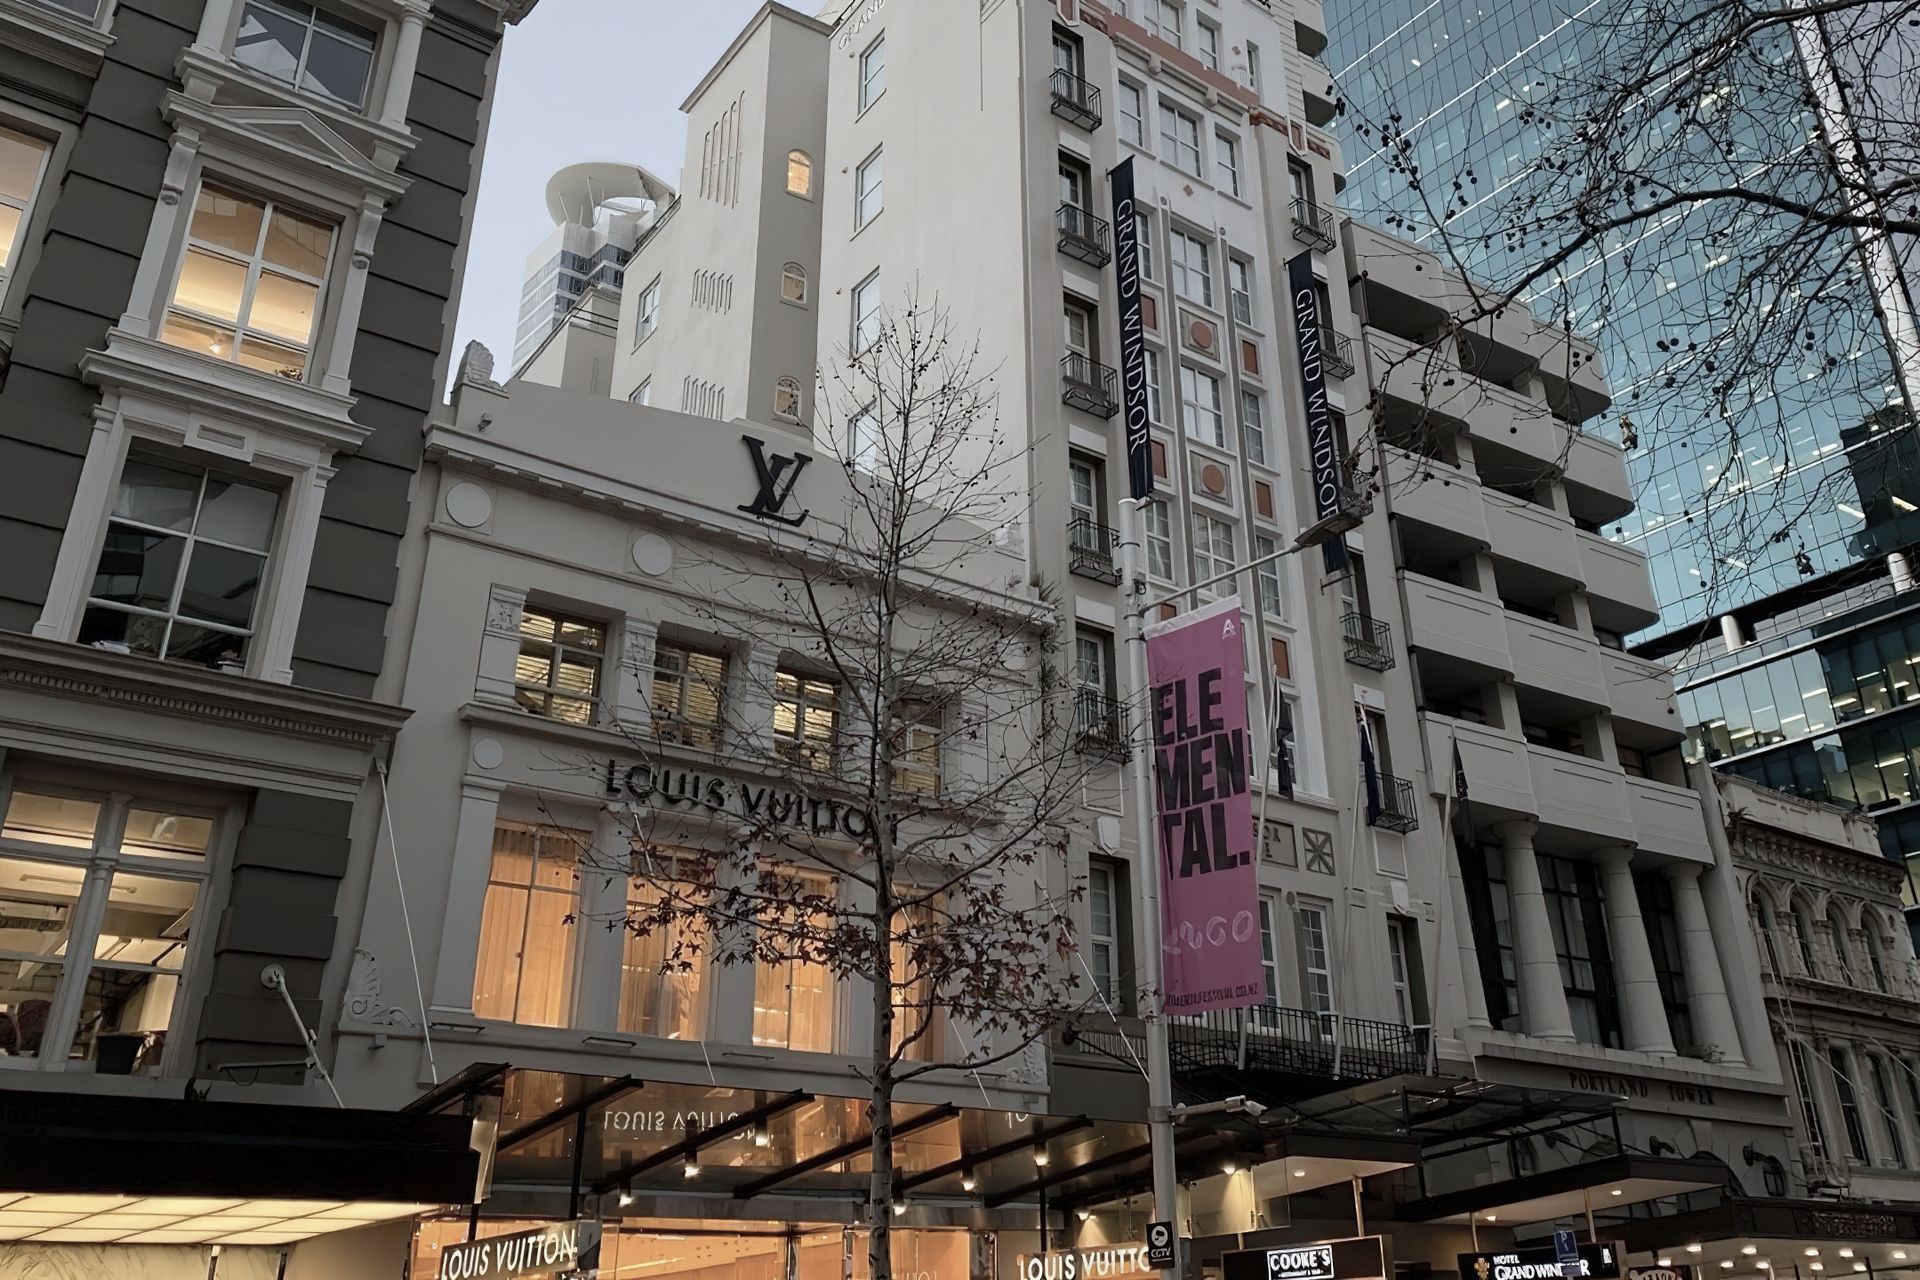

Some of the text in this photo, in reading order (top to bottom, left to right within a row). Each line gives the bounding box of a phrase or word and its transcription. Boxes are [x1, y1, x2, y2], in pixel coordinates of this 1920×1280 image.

[1116, 199, 1147, 455] GRAND WINDSOR
[1296, 289, 1322, 382] GRAND
[1150, 667, 1224, 746] ELE
[1154, 727, 1246, 811] MEN
[606, 758, 898, 846] LOUIS VUITTO
[1163, 802, 1250, 881] TAL.
[1568, 1071, 1716, 1105] PORTLAND TOWER
[441, 1229, 577, 1280] LOUIS VUITTON
[1017, 1246, 1150, 1280] LOUIS VUITTO
[1150, 1246, 1171, 1258] CCTV
[1270, 1249, 1331, 1271] COOKE'S
[1492, 1254, 1520, 1266] HOTEL
[1494, 1259, 1591, 1280] GRAND WINR
